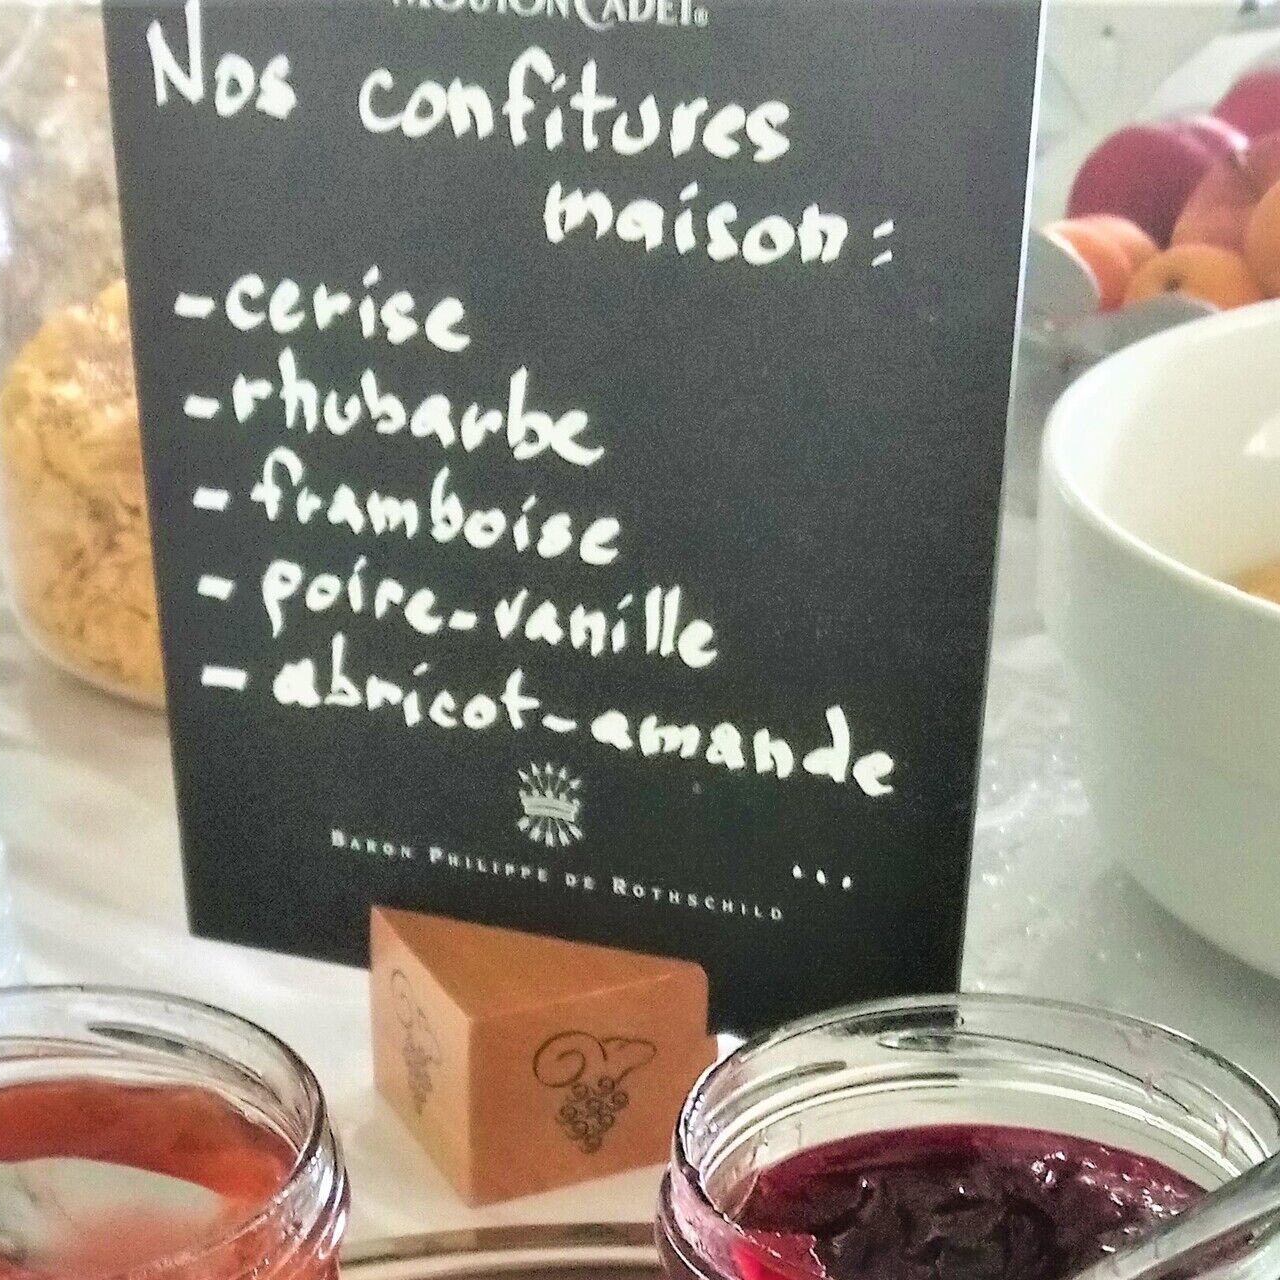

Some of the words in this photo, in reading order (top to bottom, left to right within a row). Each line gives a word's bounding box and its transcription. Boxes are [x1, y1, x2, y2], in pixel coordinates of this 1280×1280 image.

[145, 0, 300, 122] Nos
[356, 43, 792, 165] confitures
[330, 828, 413, 860] BARON
[428, 845, 549, 884] PHILIPPE
[564, 872, 595, 892] DE
[611, 876, 783, 922] ROTHSCHILD
